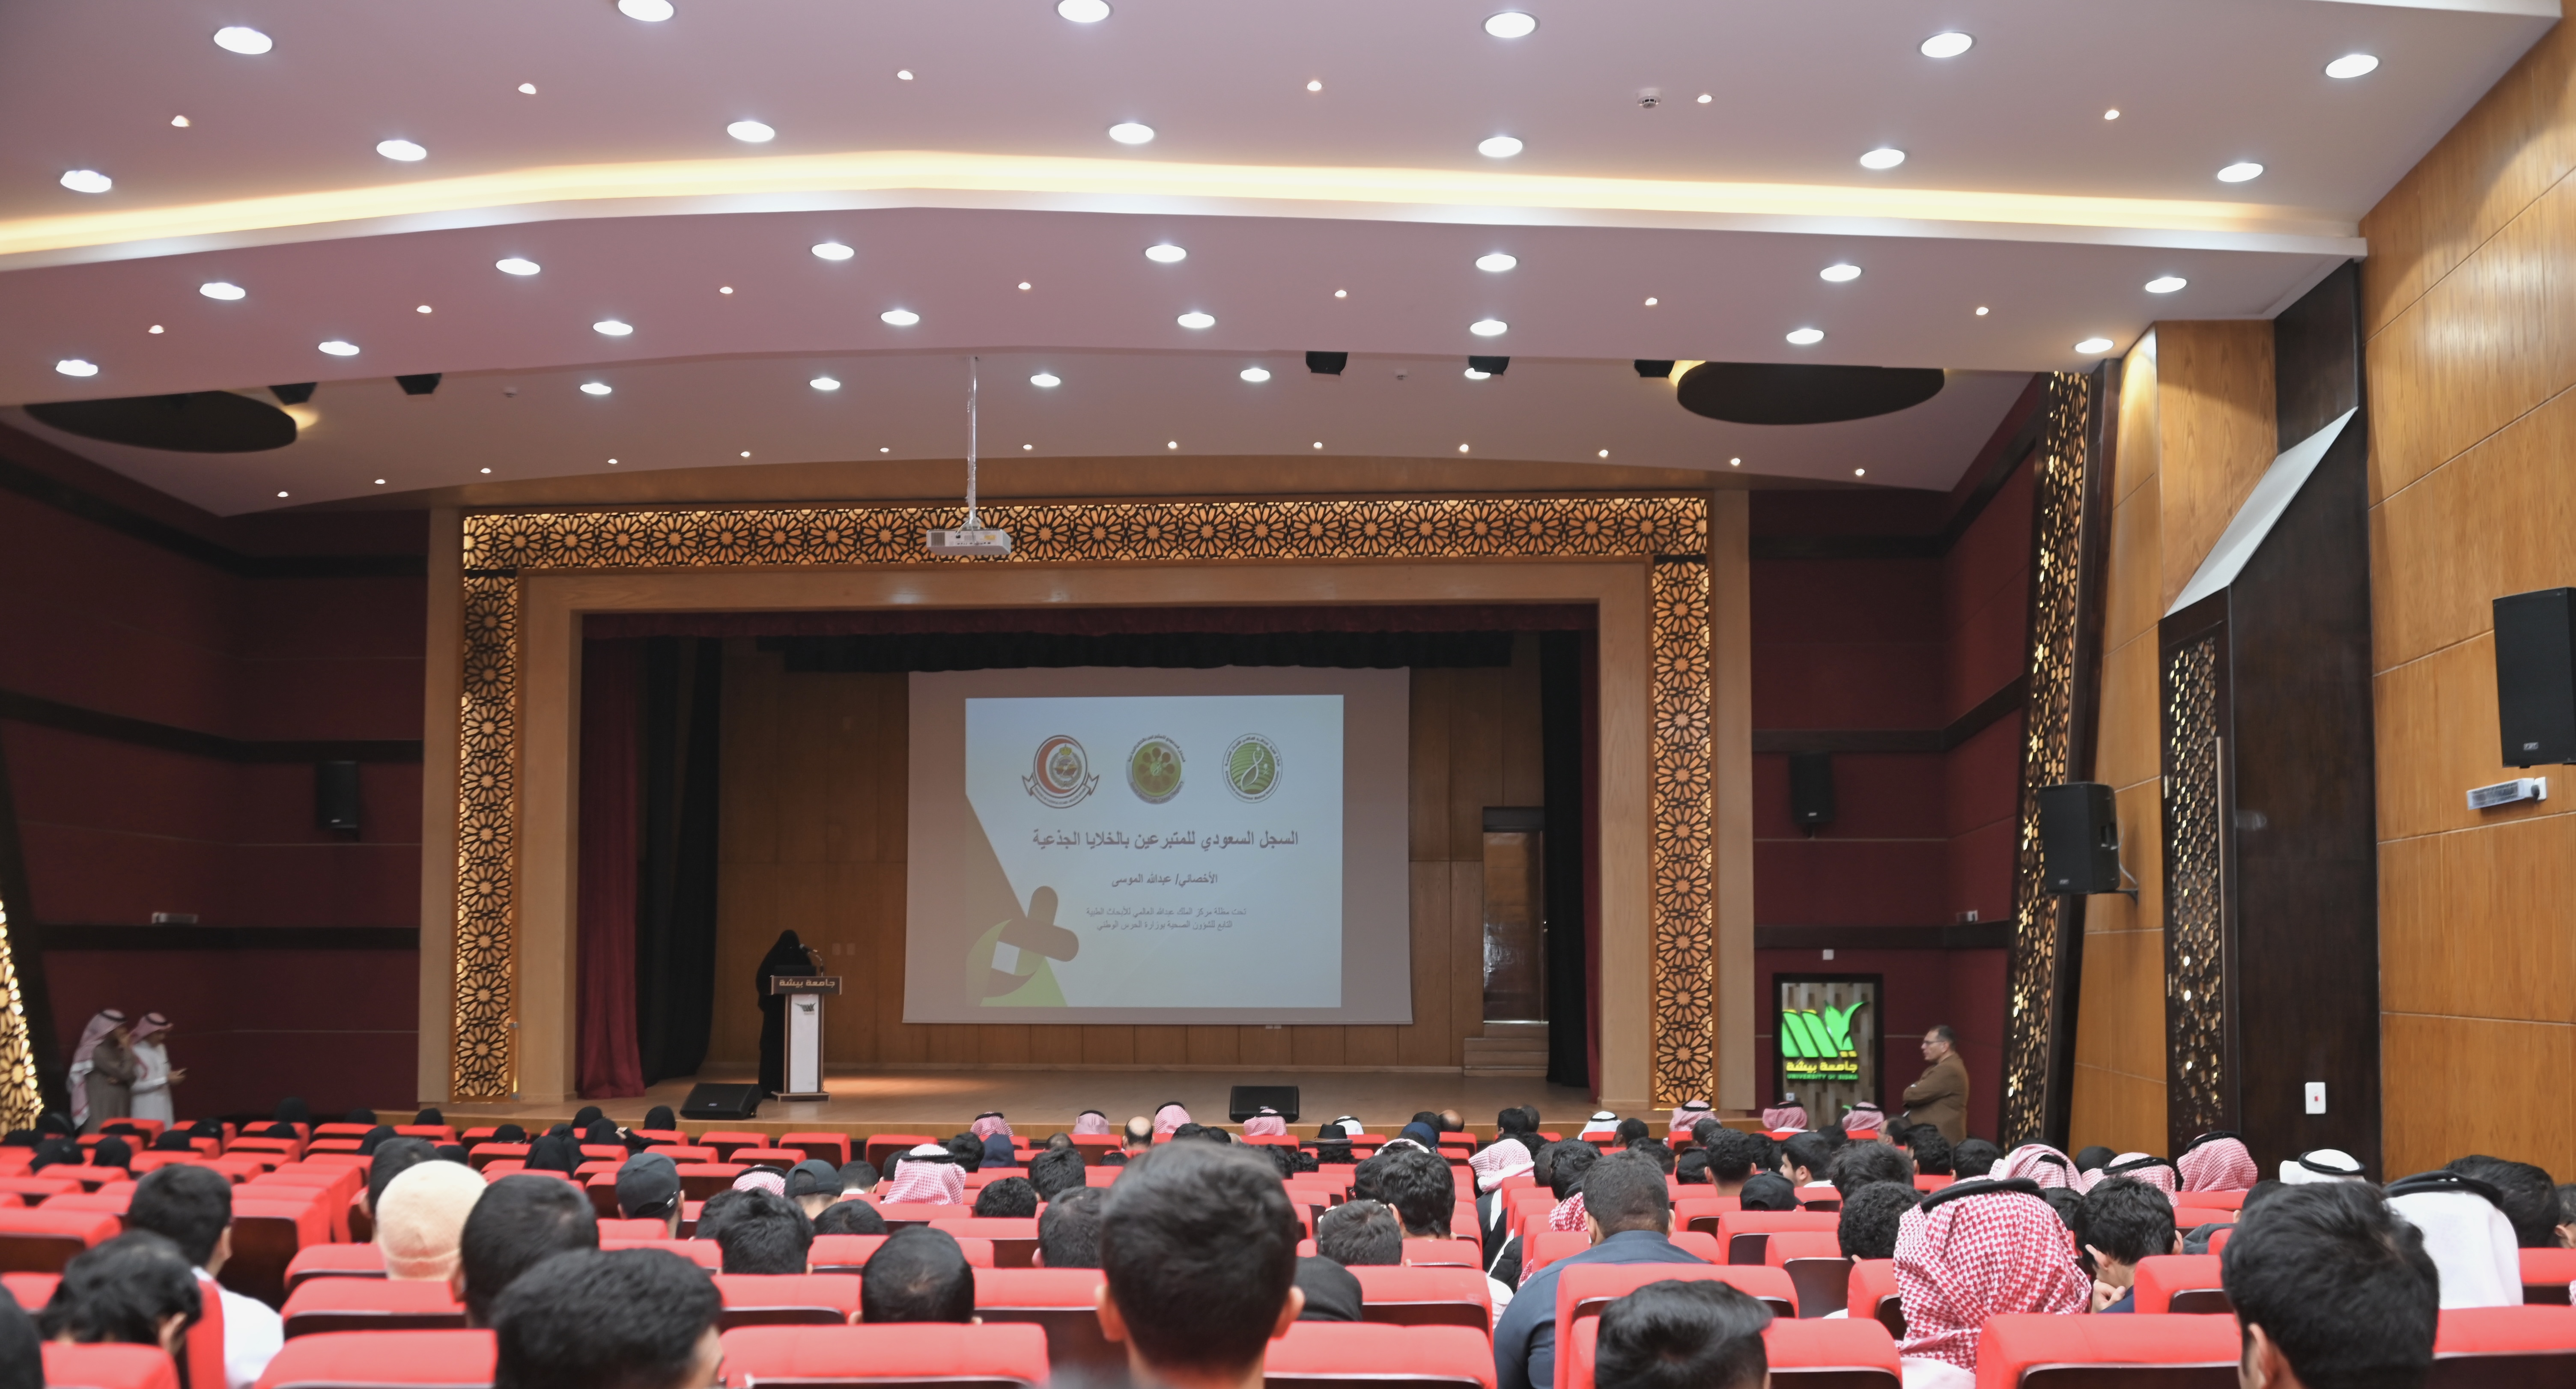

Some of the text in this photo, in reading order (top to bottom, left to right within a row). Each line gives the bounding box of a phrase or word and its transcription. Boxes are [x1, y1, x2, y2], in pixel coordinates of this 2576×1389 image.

[1033, 829, 1298, 852] السجل السعودي للمتبرعين بالخلايا الجذعية
[1112, 873, 1144, 888] الموسى
[1177, 907, 1193, 915] الملك
[1196, 908, 1212, 918] مركز
[779, 978, 835, 988] جامعة بيشة
[1786, 1060, 1858, 1073] جامعة بيشة
